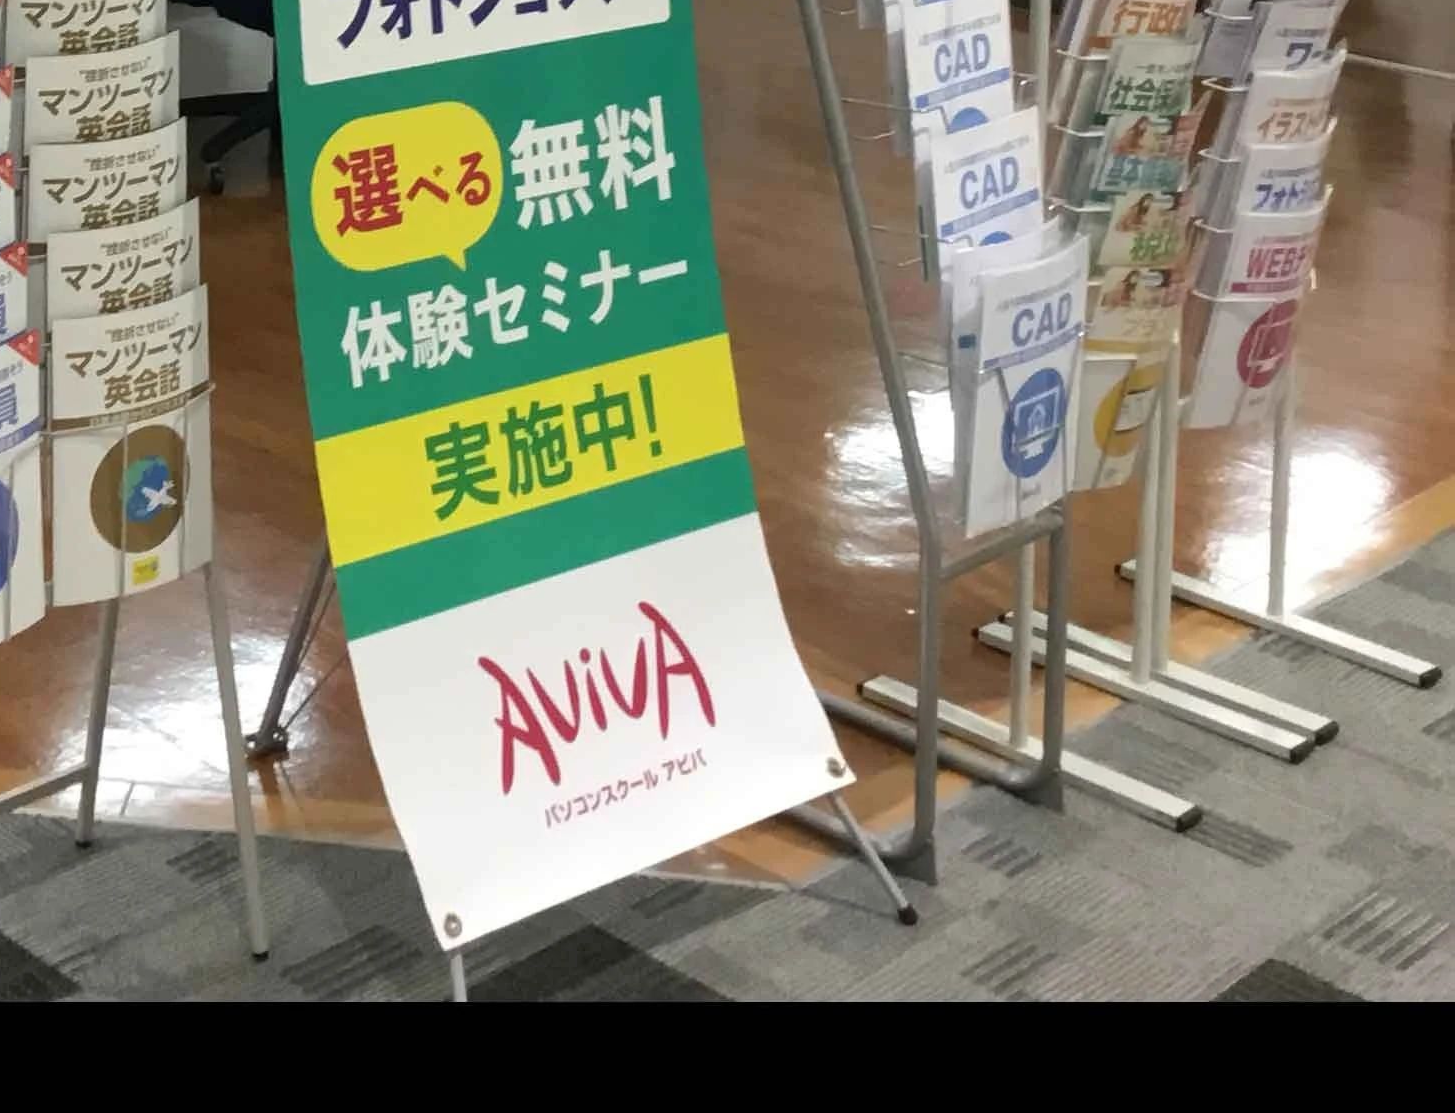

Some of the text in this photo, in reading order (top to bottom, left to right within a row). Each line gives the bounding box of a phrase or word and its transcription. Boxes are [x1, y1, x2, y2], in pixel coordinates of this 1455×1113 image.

[934, 33, 991, 84] CAD
[38, 66, 175, 116] マンツーマン
[42, 156, 180, 204] マンツーマン
[332, 144, 492, 237] 選べる
[509, 96, 676, 230] 無料
[959, 156, 1020, 210] CAD
[60, 234, 195, 293] マンツーマン
[341, 249, 688, 389] 体験セミナー
[1012, 292, 1073, 347] CAD
[65, 321, 203, 379] マンツーマン
[103, 358, 181, 409] 英会話
[424, 373, 663, 521] 実施中!
[544, 748, 707, 828] パソコンスクール アビバ
